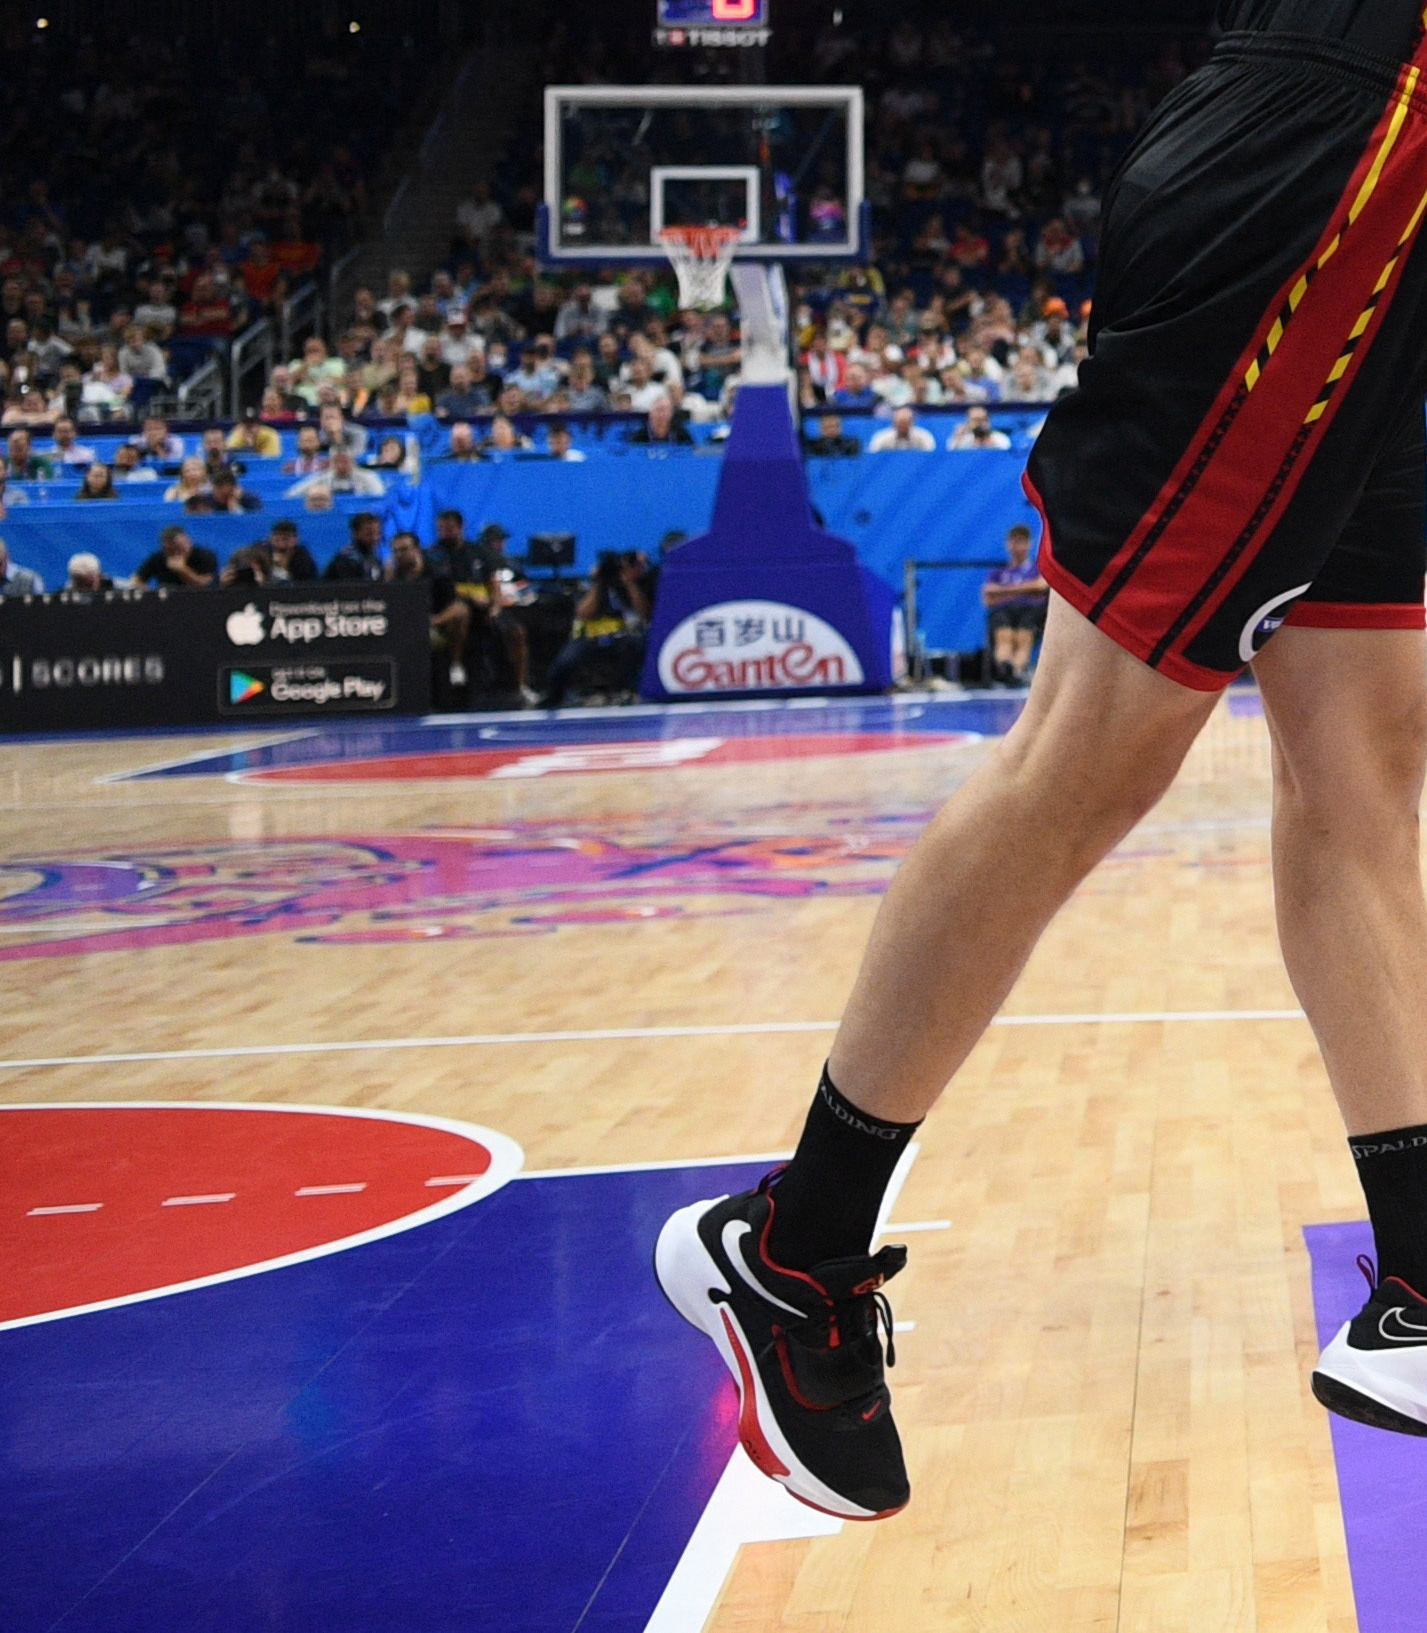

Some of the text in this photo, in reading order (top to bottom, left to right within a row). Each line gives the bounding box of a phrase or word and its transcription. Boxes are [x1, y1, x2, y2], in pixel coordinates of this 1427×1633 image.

[270, 613, 389, 643] App Store
[271, 678, 341, 704] Google
